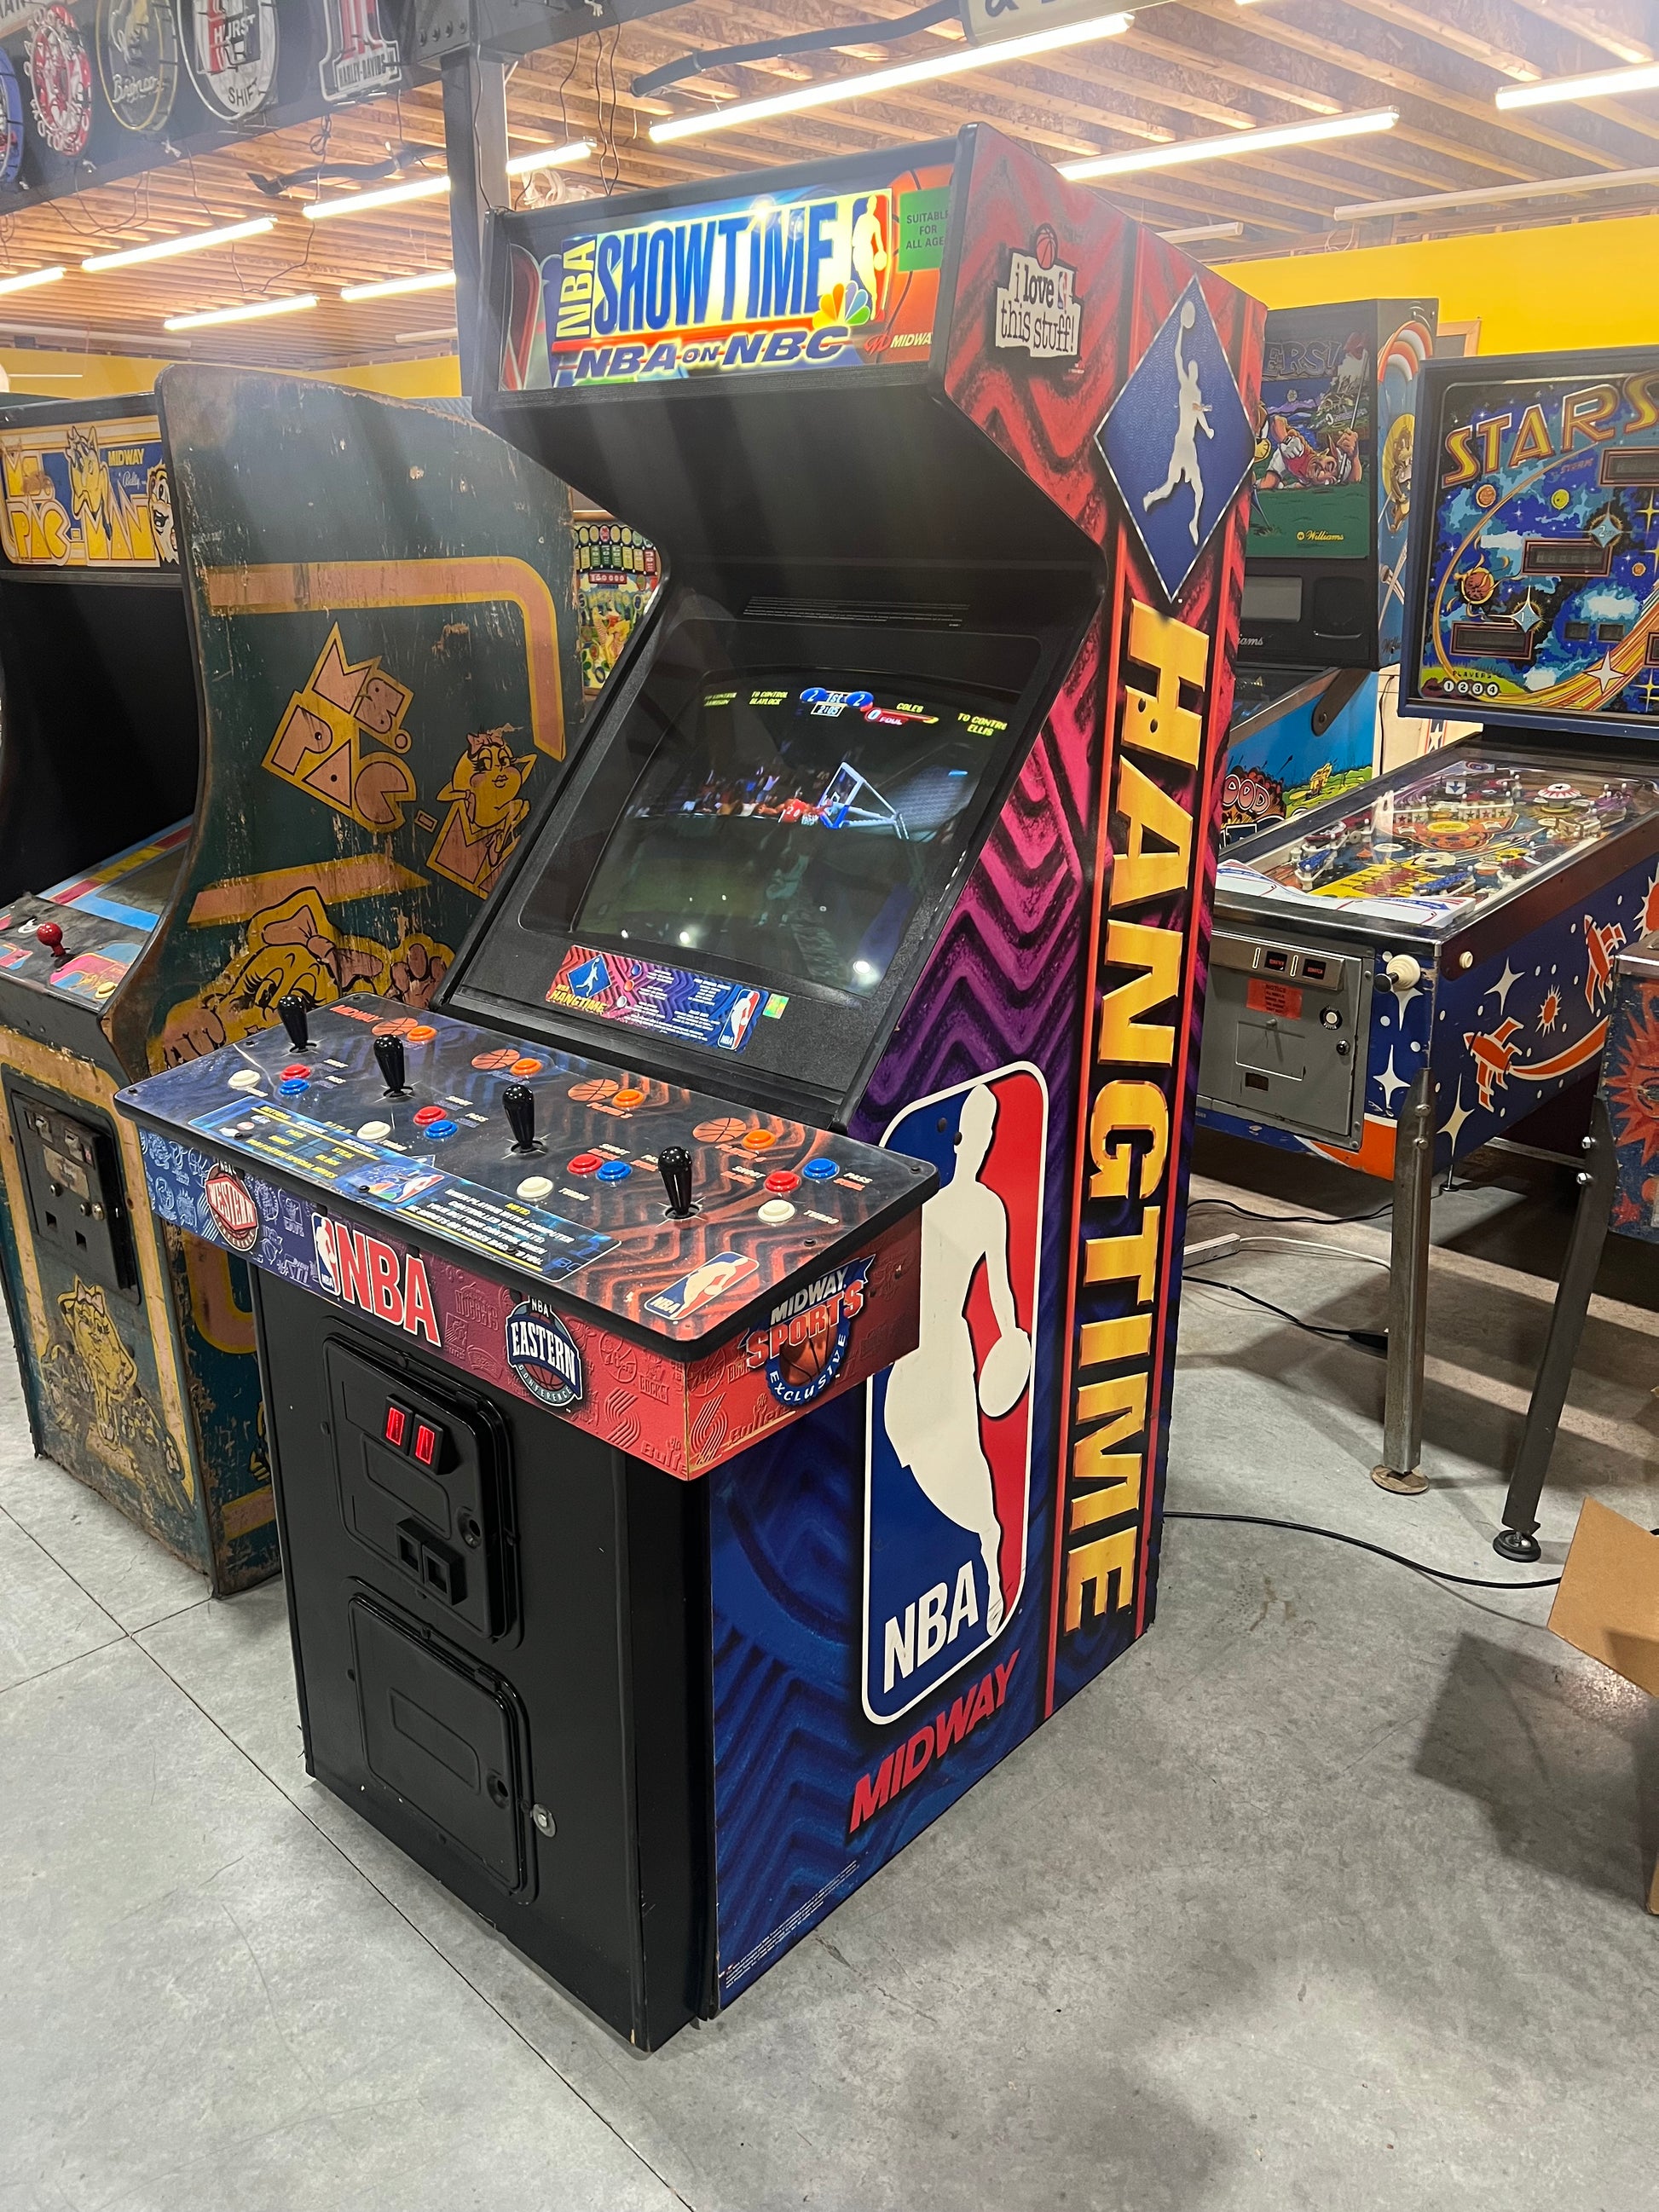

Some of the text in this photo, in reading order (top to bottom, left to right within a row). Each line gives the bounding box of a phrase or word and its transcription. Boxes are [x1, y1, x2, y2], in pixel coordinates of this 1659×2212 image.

[919, 225, 937, 235] FOR
[906, 240, 922, 250] ALL
[592, 201, 841, 338] SHOWTIME
[556, 240, 597, 338] NBA
[1023, 264, 1055, 309] love
[1000, 300, 1076, 352] this stuff!
[575, 326, 851, 380] NBA ON NBC
[107, 448, 145, 467] MIDWAY
[10, 494, 157, 561] PAC-MAN
[1305, 529, 1344, 542] Williams
[1452, 670, 1493, 679] PLAYERS
[807, 690, 819, 703] 2
[853, 694, 865, 707] 2
[896, 702, 924, 714] COLES
[879, 716, 904, 726] FOUL
[957, 713, 971, 723] TO
[967, 724, 994, 736] ELLIS
[549, 990, 608, 1014] HANGTIME
[329, 1004, 384, 1023] MIDWAY
[465, 1112, 489, 1123] PASS
[1063, 598, 1210, 1635] HANGTIME
[599, 1143, 631, 1156] SHOOT
[731, 1165, 766, 1179] SHOOT
[843, 1172, 873, 1184] PASS
[207, 1181, 254, 1227] WESTERN
[558, 1187, 591, 1202] TURBO
[803, 1209, 840, 1225] TURBO
[321, 1273, 334, 1288] NBA
[334, 1222, 442, 1348] NBA
[650, 1296, 679, 1314] NBA
[771, 1267, 848, 1325] MIDWAY
[531, 1297, 551, 1318] NBA
[746, 1279, 865, 1370] SPORTS
[511, 1320, 577, 1387] EASTERN
[769, 1333, 847, 1401] EXCLUSIVE
[518, 1363, 574, 1405] CONFERENCE
[640, 1378, 669, 1404] BUCKS
[883, 1559, 979, 1694] NBA
[849, 1649, 1020, 1834] MIDWAY
